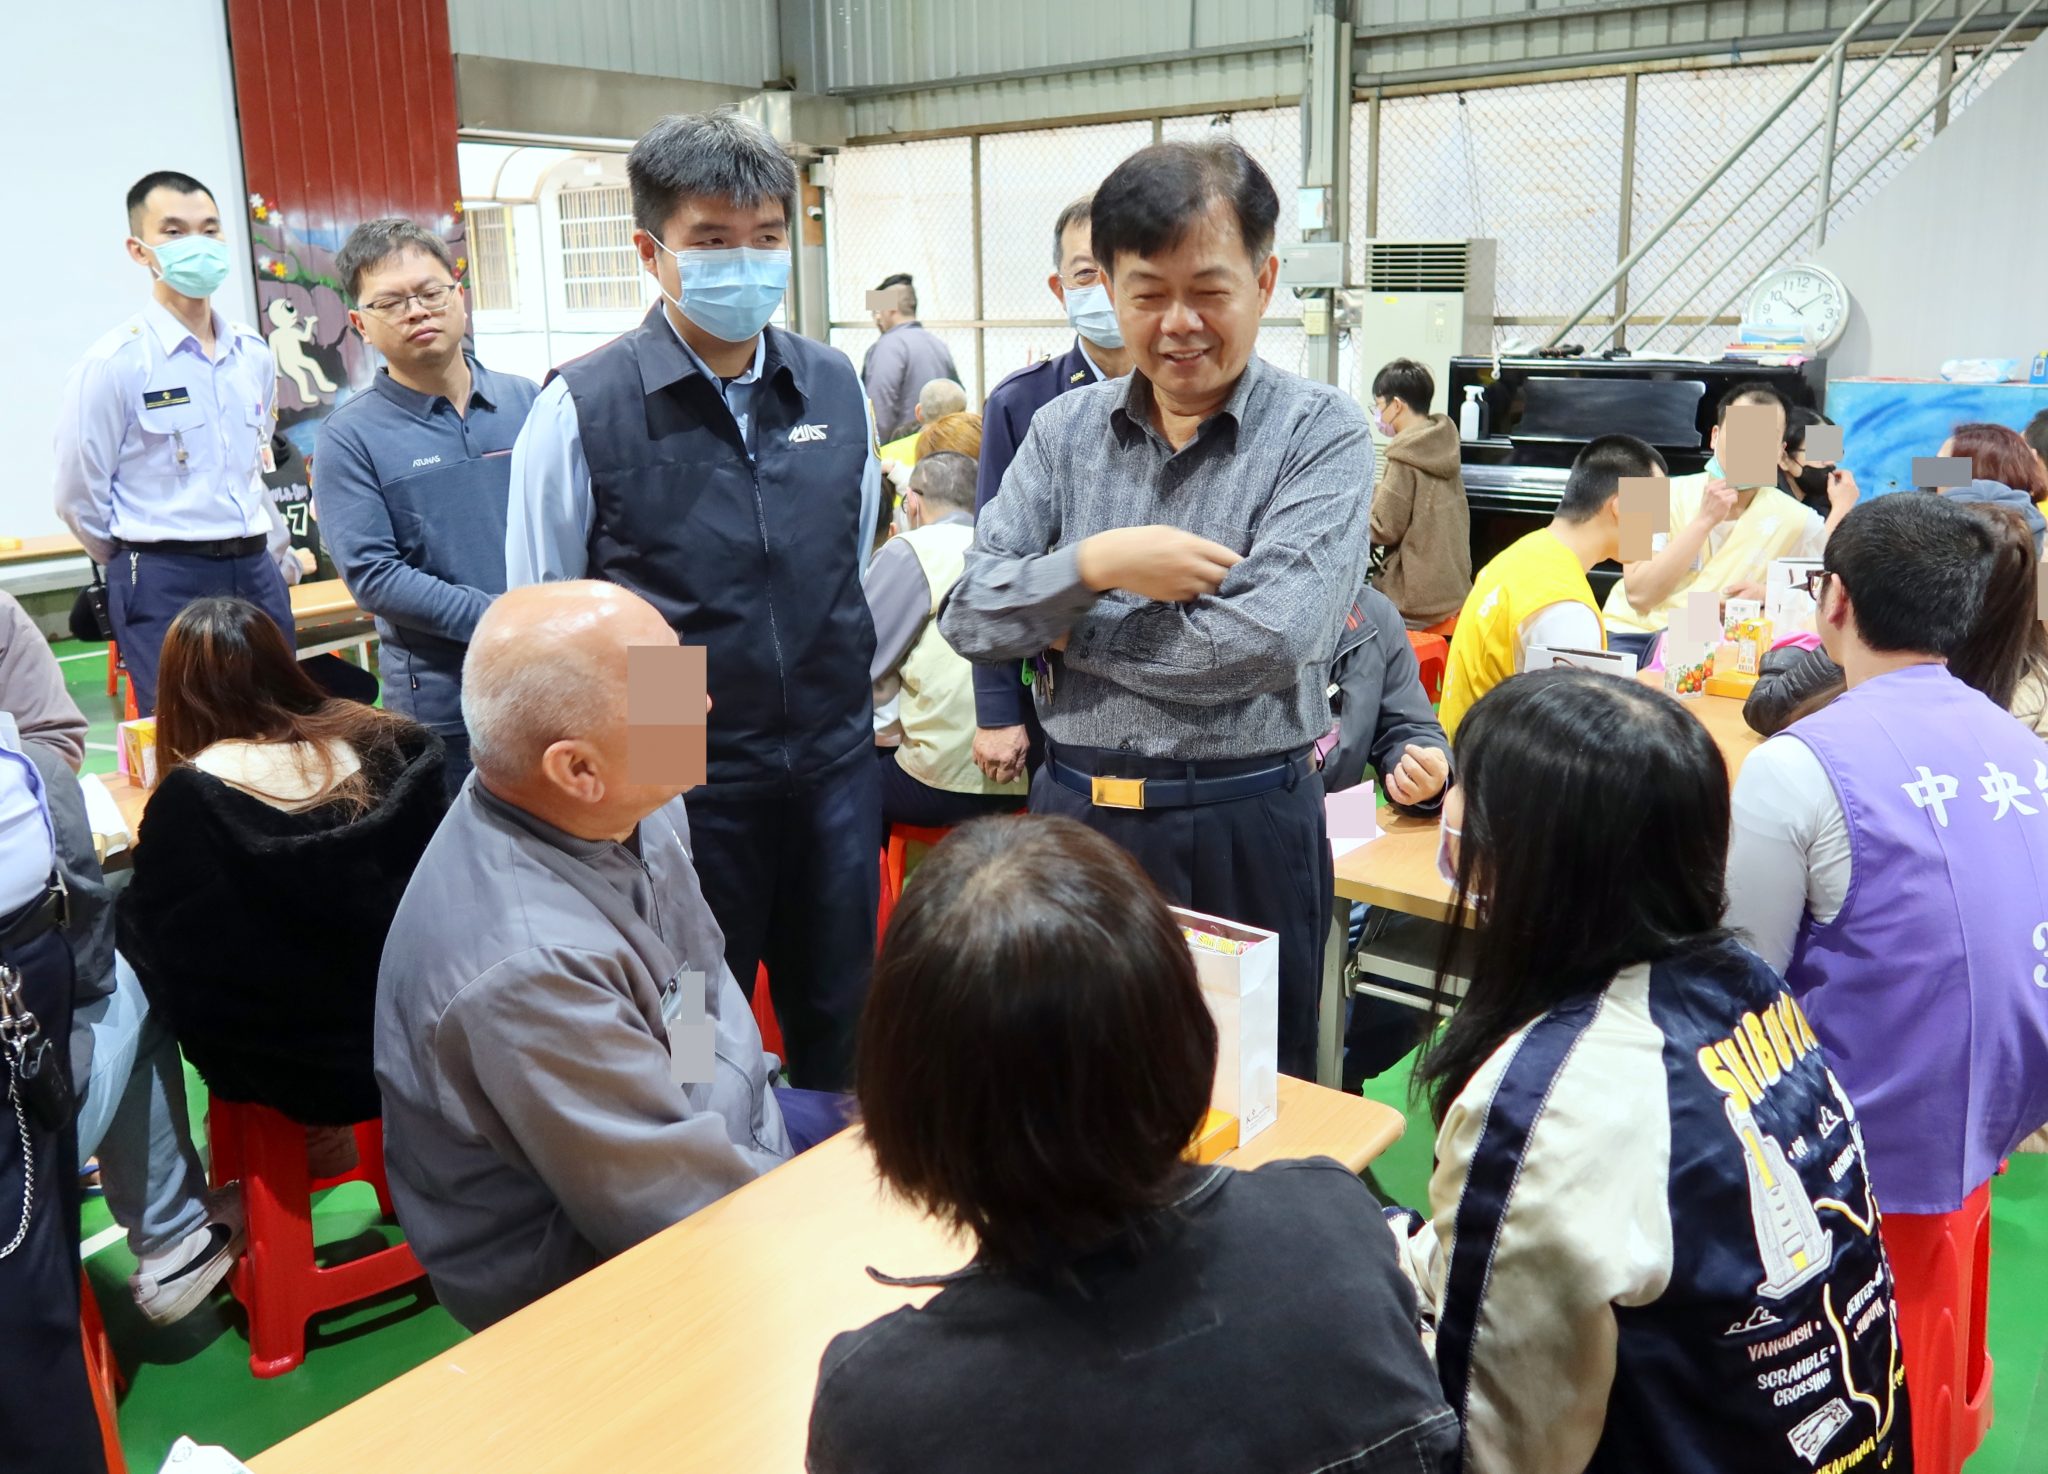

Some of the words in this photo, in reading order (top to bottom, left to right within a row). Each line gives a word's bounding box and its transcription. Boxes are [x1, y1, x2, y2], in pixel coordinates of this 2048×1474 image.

[1797, 276, 1810, 288] 12
[1770, 290, 1782, 302] 10
[1823, 293, 1832, 305] 2
[1762, 303, 1771, 315] 9
[1824, 308, 1834, 319] 3
[1816, 322, 1825, 333] 4
[1697, 990, 1820, 1119] SHIBUYA
[1748, 1321, 1813, 1362] VANQUISH
[1758, 1346, 1829, 1390] SCRAMBLE
[1773, 1367, 1832, 1407] CROSSING
